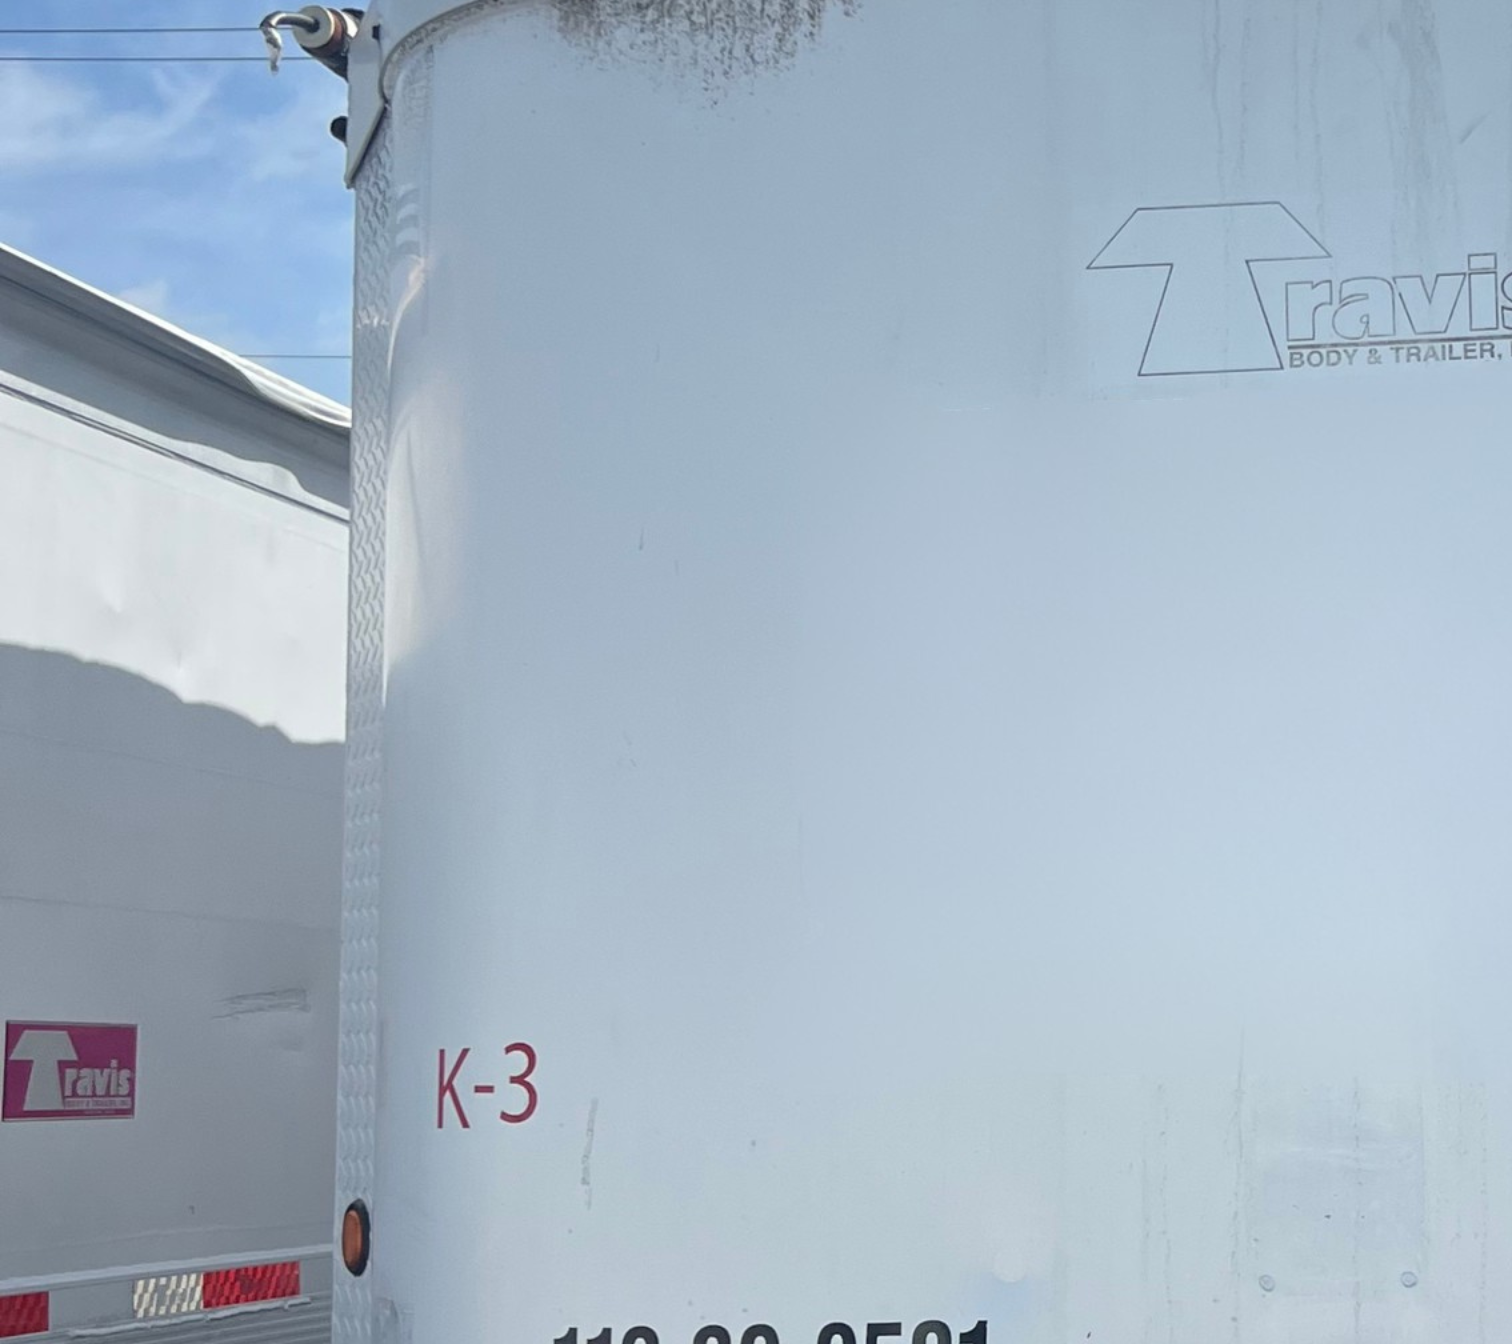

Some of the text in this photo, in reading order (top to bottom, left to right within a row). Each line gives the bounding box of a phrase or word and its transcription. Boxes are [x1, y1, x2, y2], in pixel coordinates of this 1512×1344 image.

[1288, 348, 1359, 369] BODY
[1367, 347, 1382, 365] &
[1390, 341, 1502, 364] TRAILER,
[8, 1029, 132, 1112] Travis
[436, 1042, 539, 1130] K-3
